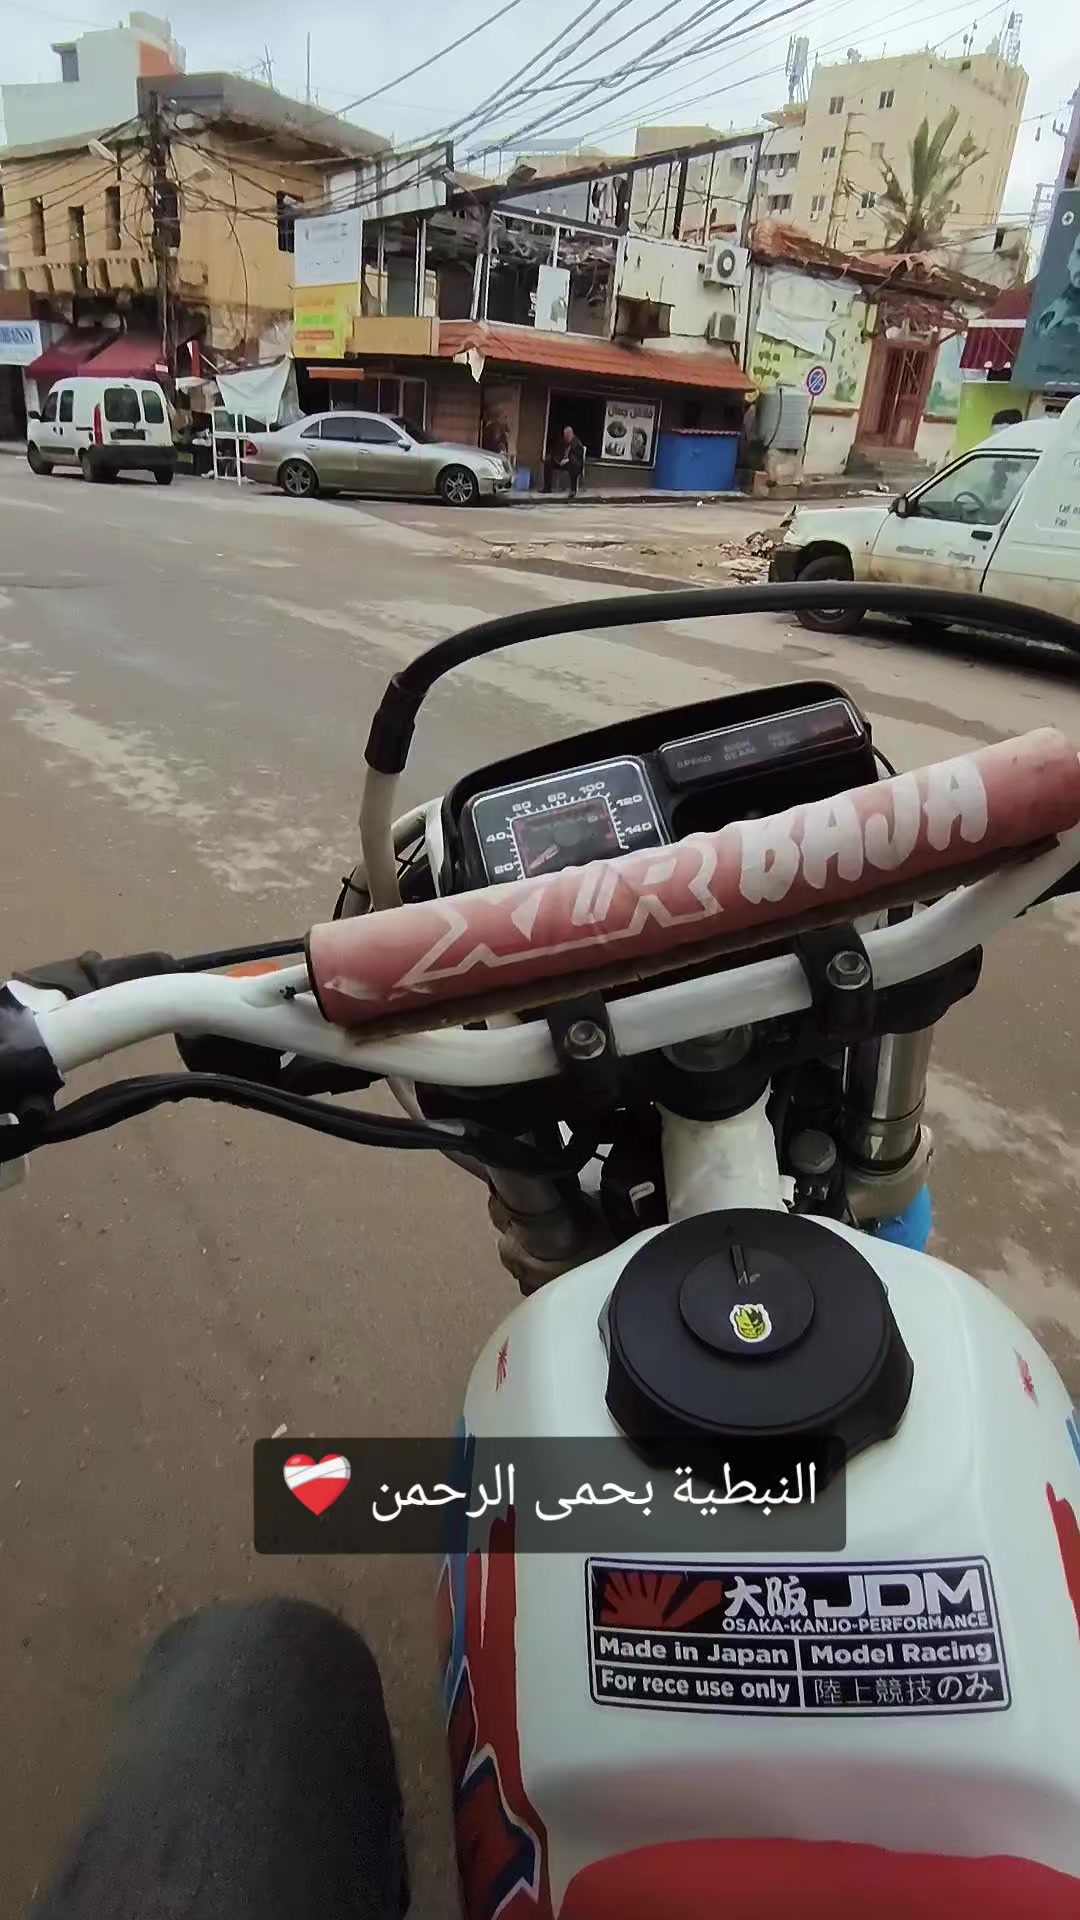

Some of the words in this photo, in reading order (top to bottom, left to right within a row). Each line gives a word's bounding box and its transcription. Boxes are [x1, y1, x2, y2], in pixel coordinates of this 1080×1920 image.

[579, 782, 606, 794] 100
[616, 794, 643, 806] 120
[486, 831, 506, 843] 40
[625, 821, 652, 835] 140
[740, 765, 989, 904] BAJA
[724, 1575, 808, 1618] 大阪
[813, 1569, 986, 1618] JDM
[721, 1611, 989, 1634] OSAKA-KANJO-PERFORMANCE
[600, 1636, 667, 1659] Made
[674, 1641, 699, 1661] in
[707, 1643, 789, 1666] Japan
[810, 1643, 895, 1665] Model
[901, 1640, 993, 1663] Racing
[601, 1668, 637, 1691] For
[642, 1676, 690, 1695] rece
[695, 1679, 735, 1697] use
[740, 1678, 790, 1703] only
[814, 1671, 994, 1705] 陸上競技のみ
